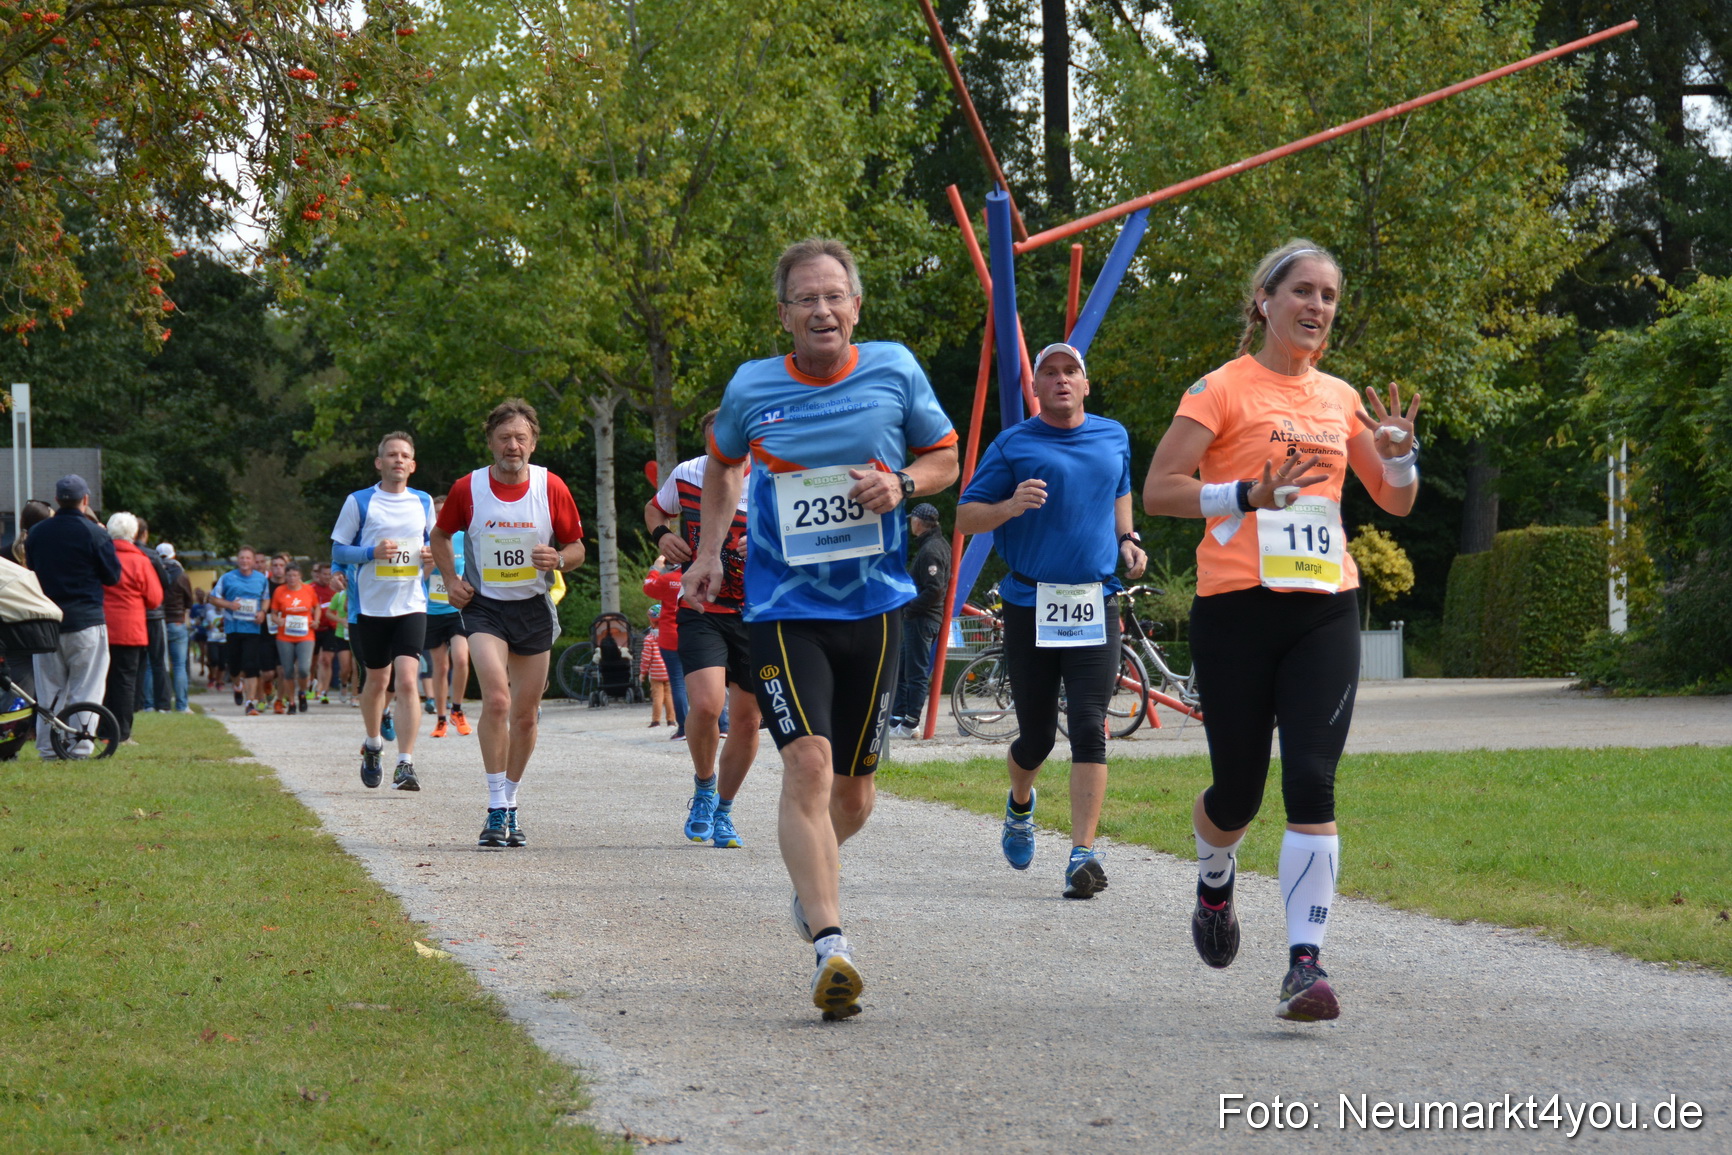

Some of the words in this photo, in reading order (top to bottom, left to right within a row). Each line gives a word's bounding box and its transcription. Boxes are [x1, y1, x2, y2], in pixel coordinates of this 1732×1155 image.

[789, 396, 852, 413] Raiffeisenbank
[867, 400, 879, 408] eG
[1269, 429, 1340, 443] Atzenhofer
[813, 474, 847, 485] BOCK
[793, 494, 864, 528] 2335
[1295, 504, 1327, 515] BOCK
[815, 533, 851, 546] Johann
[1283, 523, 1330, 554] 119
[493, 549, 525, 567] 168
[500, 571, 520, 579] Rainer
[1295, 561, 1322, 575] Margit
[1046, 603, 1094, 622] 2149
[764, 678, 796, 735] SKINS
[869, 691, 890, 754] SKINS
